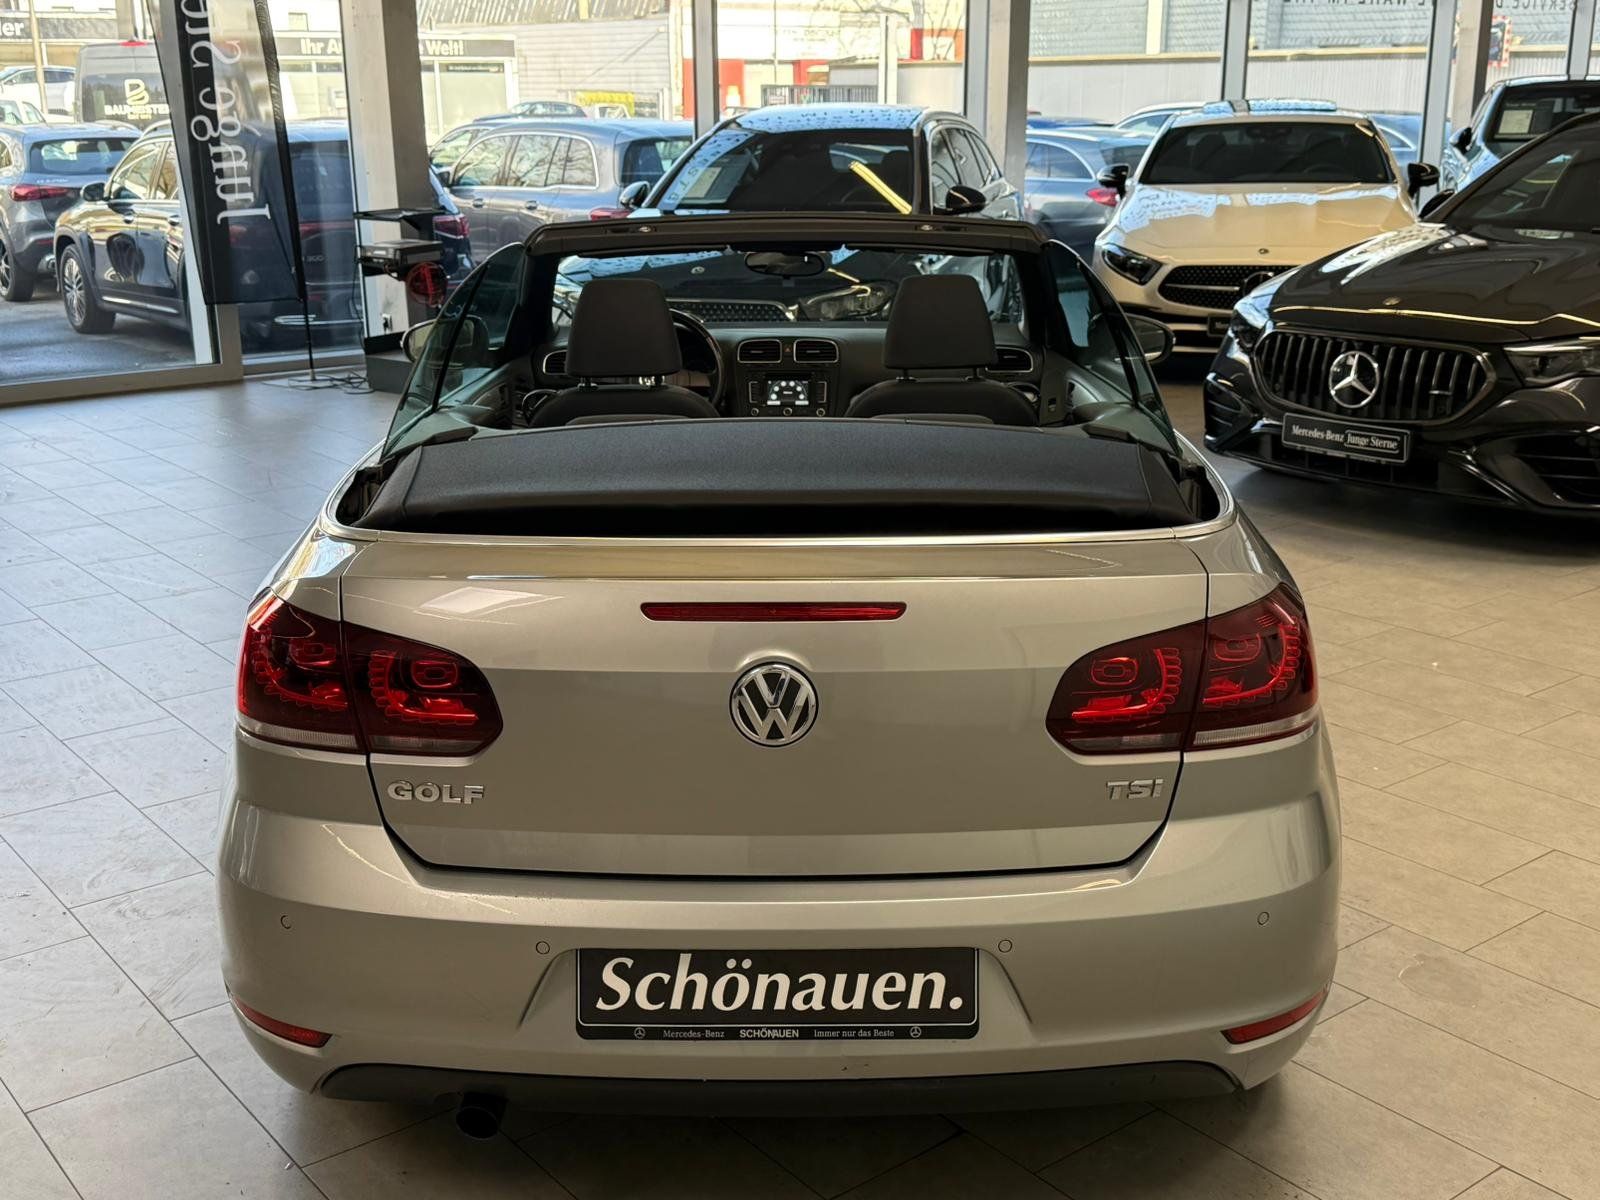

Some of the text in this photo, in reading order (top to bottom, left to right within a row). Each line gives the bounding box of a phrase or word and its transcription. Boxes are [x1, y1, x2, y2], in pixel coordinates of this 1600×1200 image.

[0, 20, 25, 37] er
[300, 38, 324, 55] Ihr
[1291, 424, 1399, 450] Mercedes-Benz Junge Sterne
[387, 780, 485, 805] GOLF
[1106, 778, 1164, 800] TSI
[595, 952, 964, 1012] Schönauen.
[662, 1028, 895, 1039] Mercedes-Benz SCHÖNAUEN Immer nur das Beste
